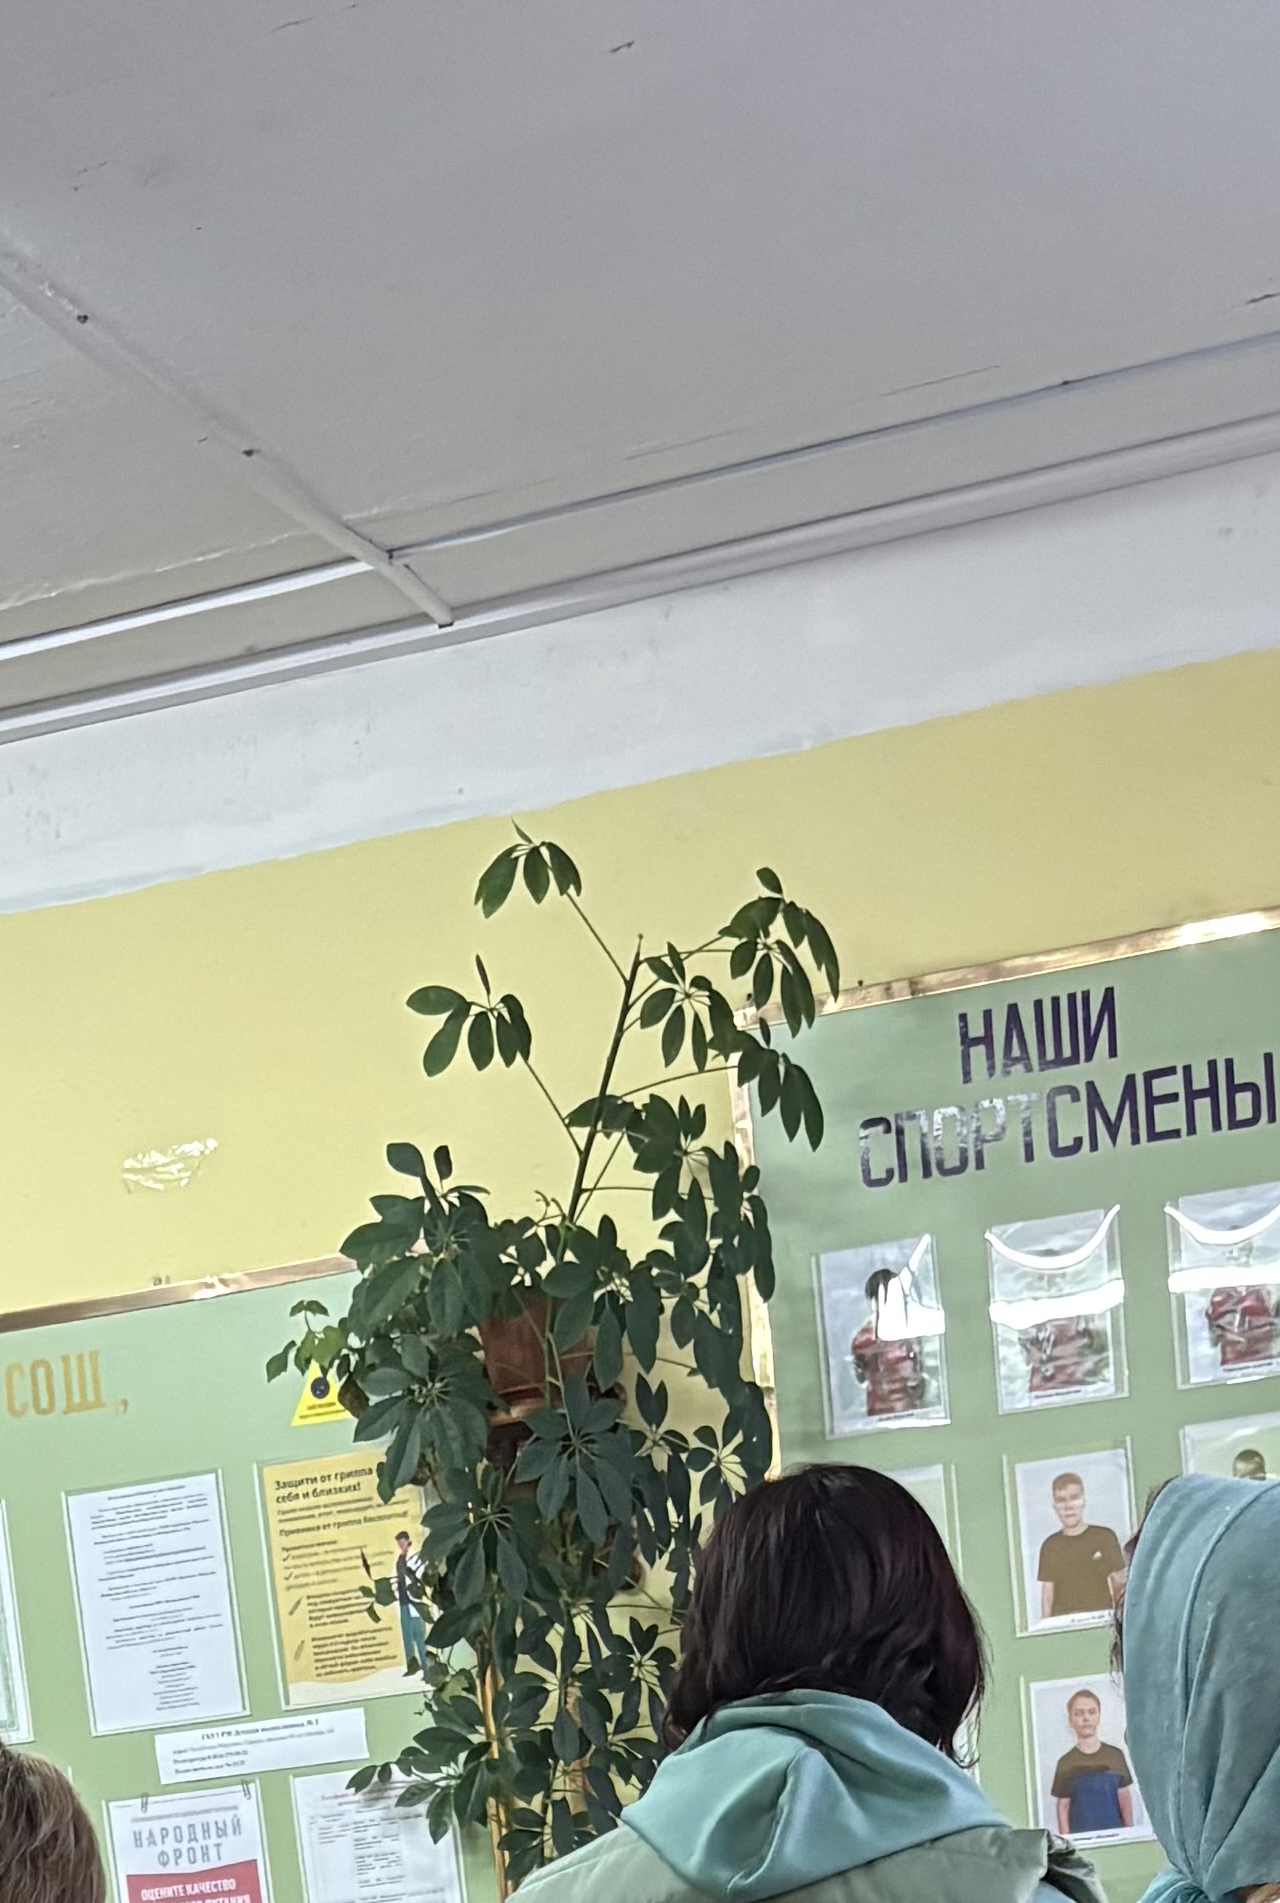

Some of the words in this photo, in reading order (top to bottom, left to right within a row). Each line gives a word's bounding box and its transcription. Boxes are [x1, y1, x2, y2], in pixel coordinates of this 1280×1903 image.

[958, 986, 1119, 1085] НАШИ
[858, 1051, 1277, 1188] СПОРТСМЕНЫ
[274, 1476, 318, 1491] Защити
[320, 1474, 332, 1483] от
[334, 1467, 374, 1482] гриппа
[275, 1492, 300, 1504] себя
[133, 1814, 242, 1848] НАРОДНЫЙ
[157, 1843, 223, 1868] ФРОНТ
[141, 1884, 186, 1901] ОЦЕНИТЕ
[186, 1878, 236, 1896] КАЧЕСТВО
